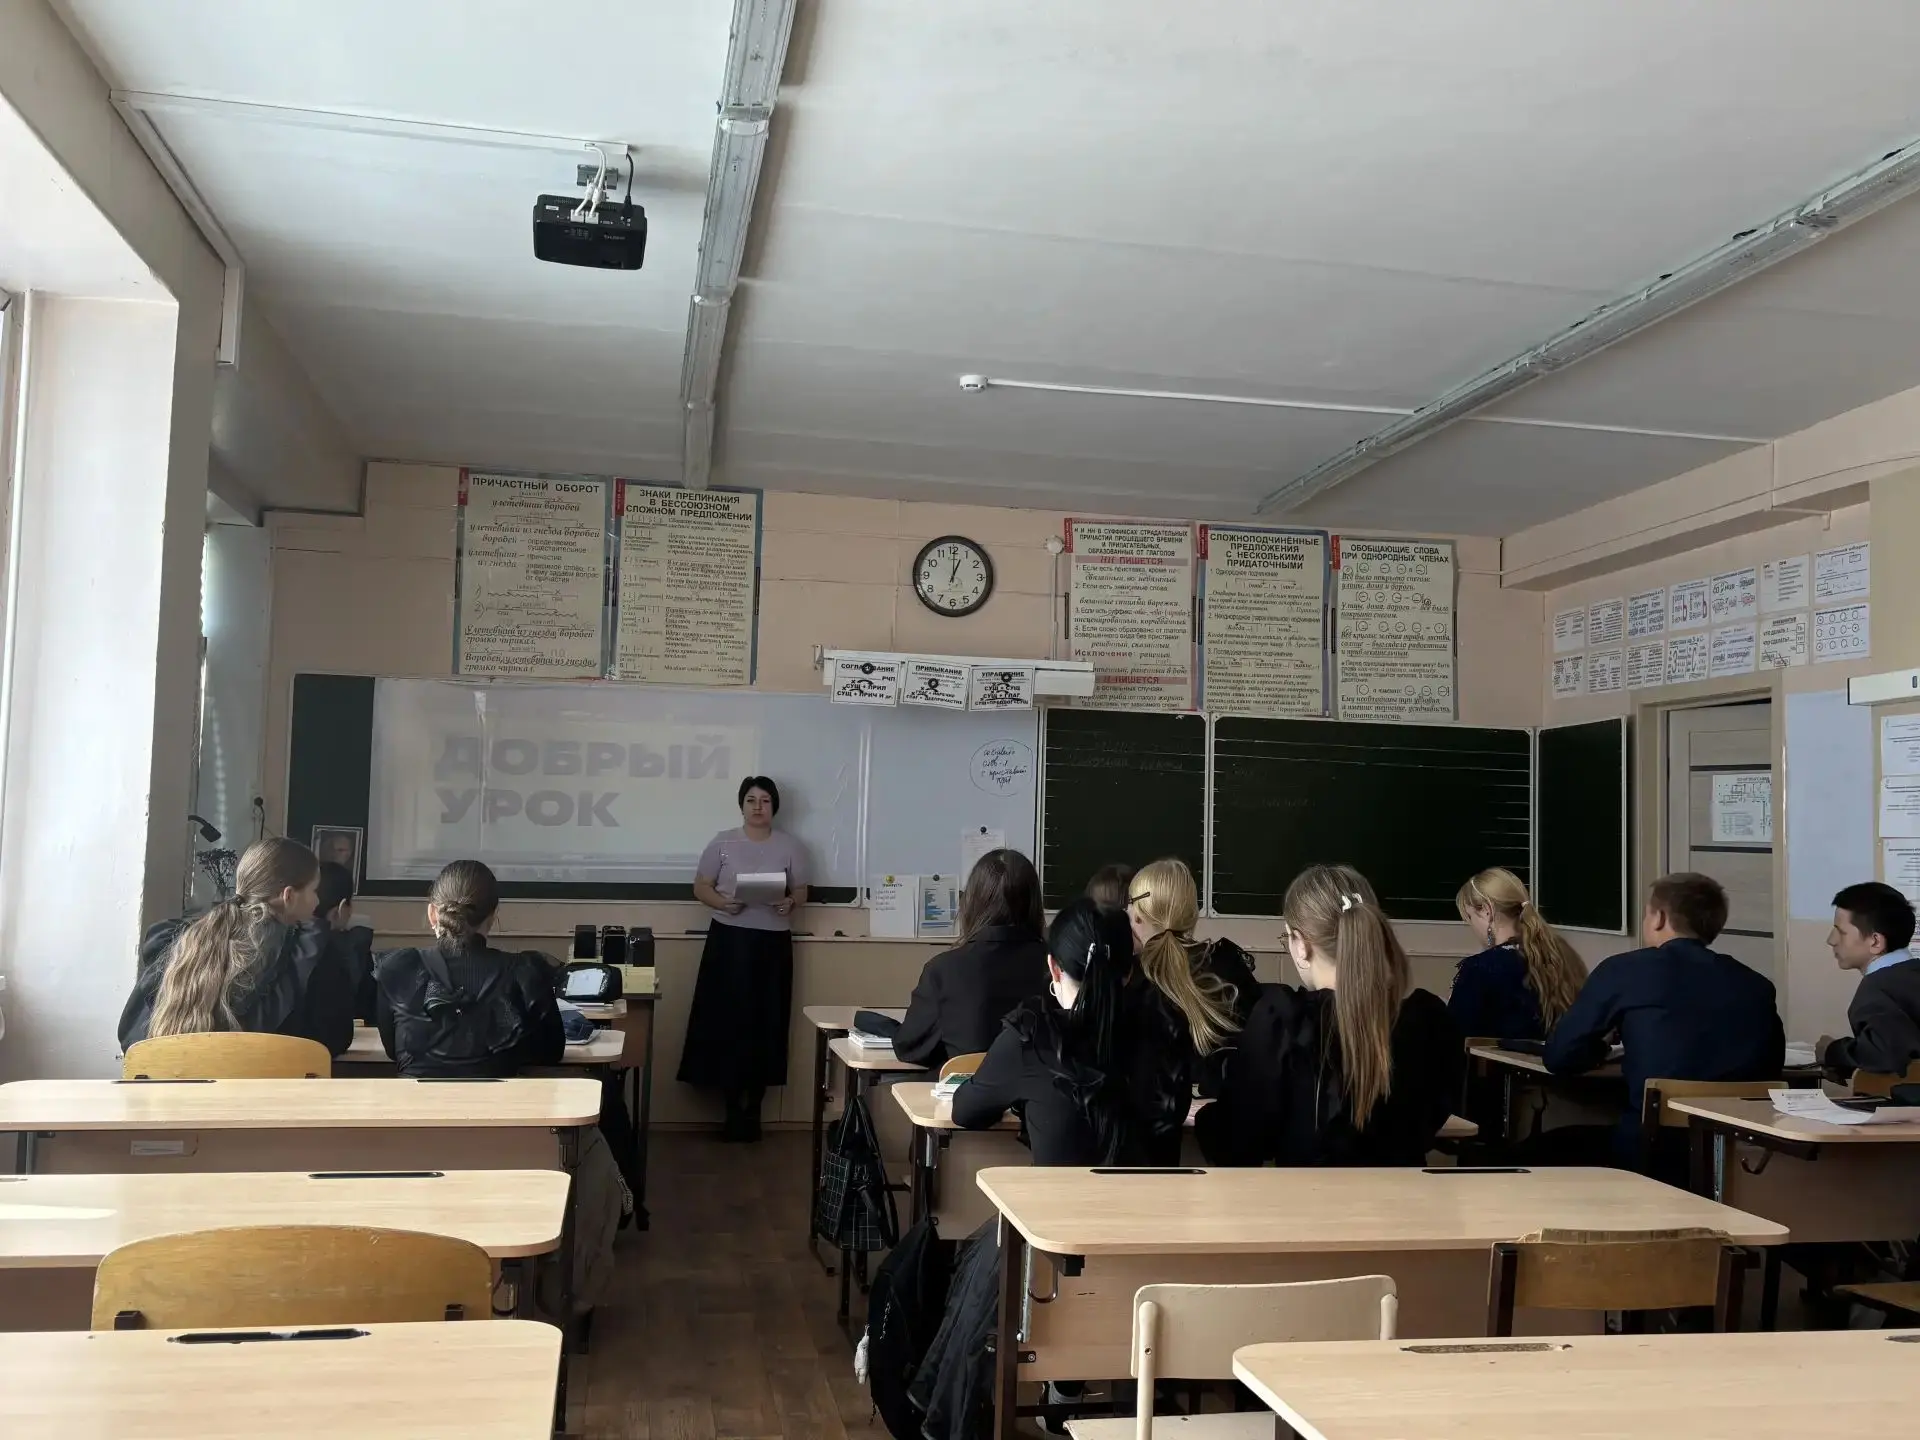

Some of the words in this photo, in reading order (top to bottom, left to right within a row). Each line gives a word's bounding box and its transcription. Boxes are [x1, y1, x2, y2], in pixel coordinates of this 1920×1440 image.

[473, 477, 549, 490] ПРИЧАСТНЫЙ
[555, 484, 600, 493] ОБОРОТ
[640, 489, 671, 499] ЗНАКИ
[676, 492, 740, 504] ПРЕПИНАНИЯ
[662, 500, 730, 512] БЕССОЮЗНОМ
[626, 505, 676, 516] СЛОЖНОМ
[680, 509, 753, 521] ПРЕДЛОЖЕНИИ
[1079, 534, 1113, 542] ПРИЧАСТИЙ
[1210, 533, 1320, 546] СЛОЖНОПОДЧИНЁННЫЕ
[948, 546, 959, 555] 12
[1230, 543, 1299, 553] ПРЕДЛОЖЕНИЯ
[1350, 544, 1410, 554] ОБОБЩАЮЩИЕ
[937, 549, 945, 558] 11
[1237, 551, 1304, 561] НЕСКОЛЬКИМИ
[1361, 553, 1415, 562] ОДНОРОДНЫХ
[927, 559, 938, 568] 10
[972, 560, 980, 569] 2
[1119, 556, 1163, 565] ПИШЕТСЯ
[1227, 559, 1303, 569] ПРИДАТОЧНЫМИ
[923, 571, 930, 580] 9
[976, 574, 984, 582] 3
[927, 584, 934, 593] 8
[972, 586, 979, 594] 4
[938, 594, 944, 603] 7
[949, 598, 956, 607] 6
[962, 595, 970, 604] 5
[1074, 648, 1136, 657] Исключение:
[915, 665, 963, 676] ПРИМЫКАНИЕ
[1115, 676, 1159, 684] ПИШЕТСЯ
[434, 734, 731, 782] ДОБРЫЙ
[435, 788, 622, 827] УРОК
